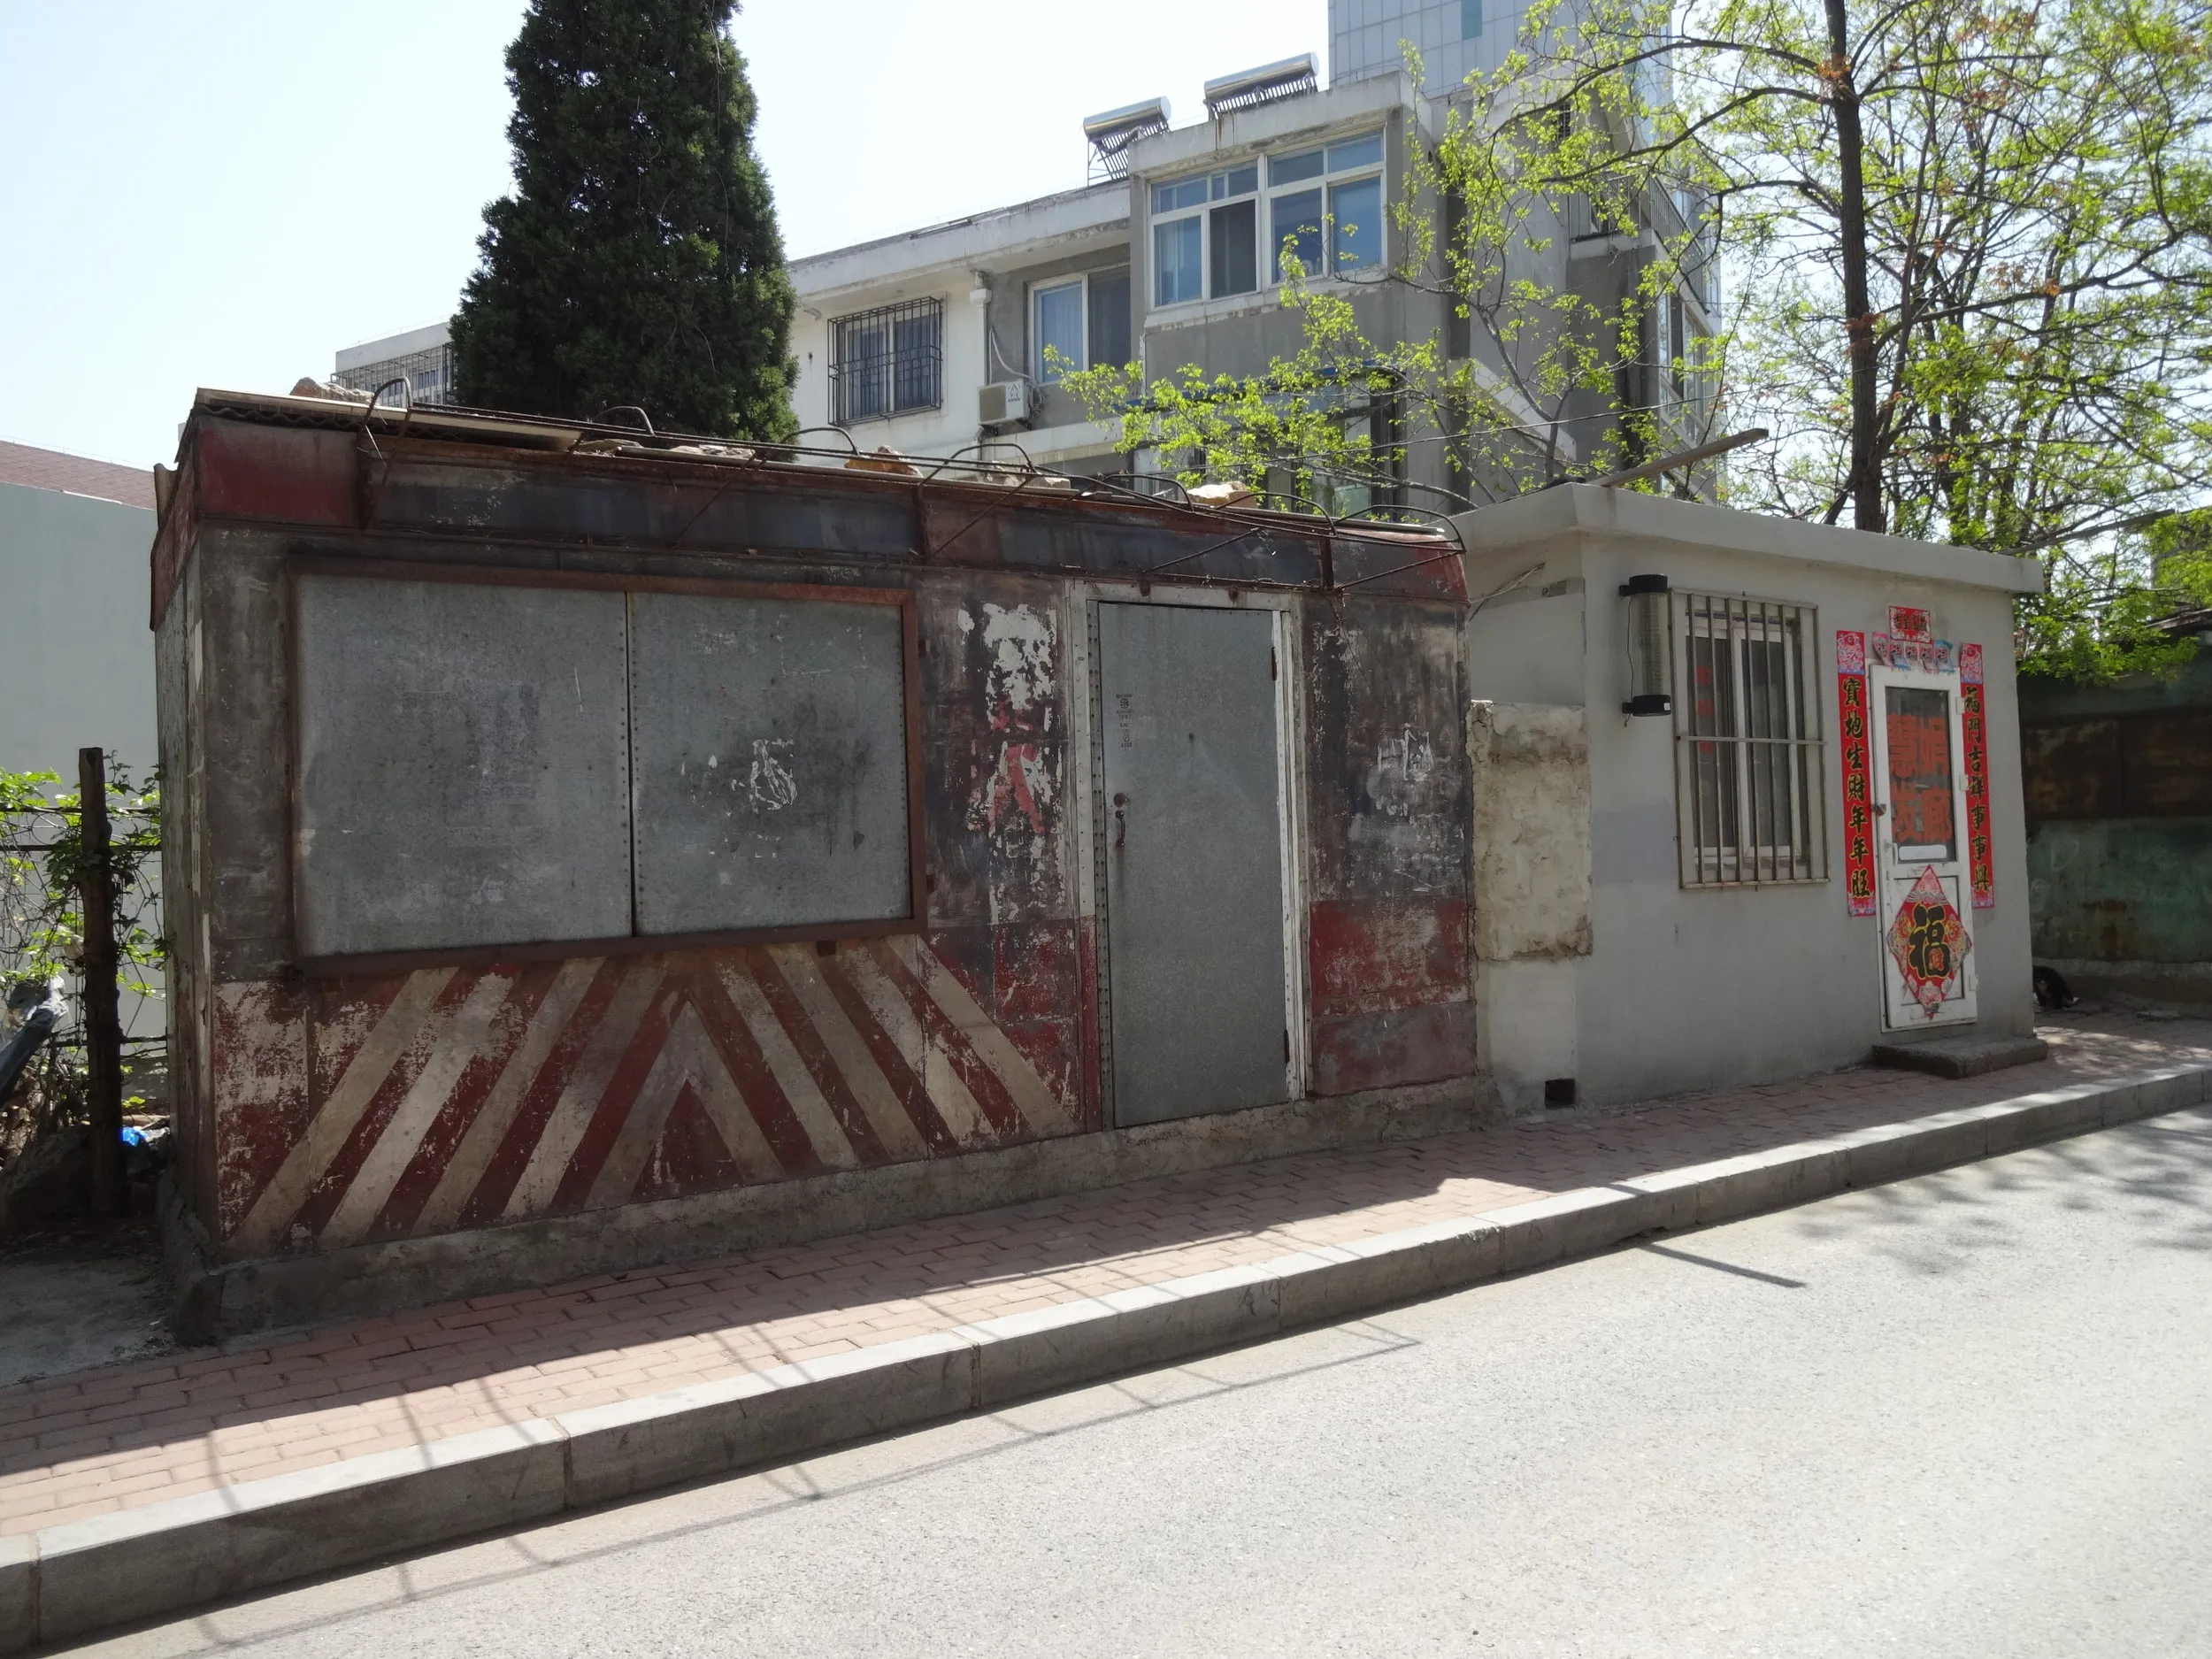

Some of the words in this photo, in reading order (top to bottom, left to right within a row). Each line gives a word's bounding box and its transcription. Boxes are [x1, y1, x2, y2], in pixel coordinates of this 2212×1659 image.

[1842, 676, 1870, 899] 寶地生財年年旺
[1963, 686, 1990, 894] 福門吉祥事事興
[1908, 901, 1951, 979] 福
